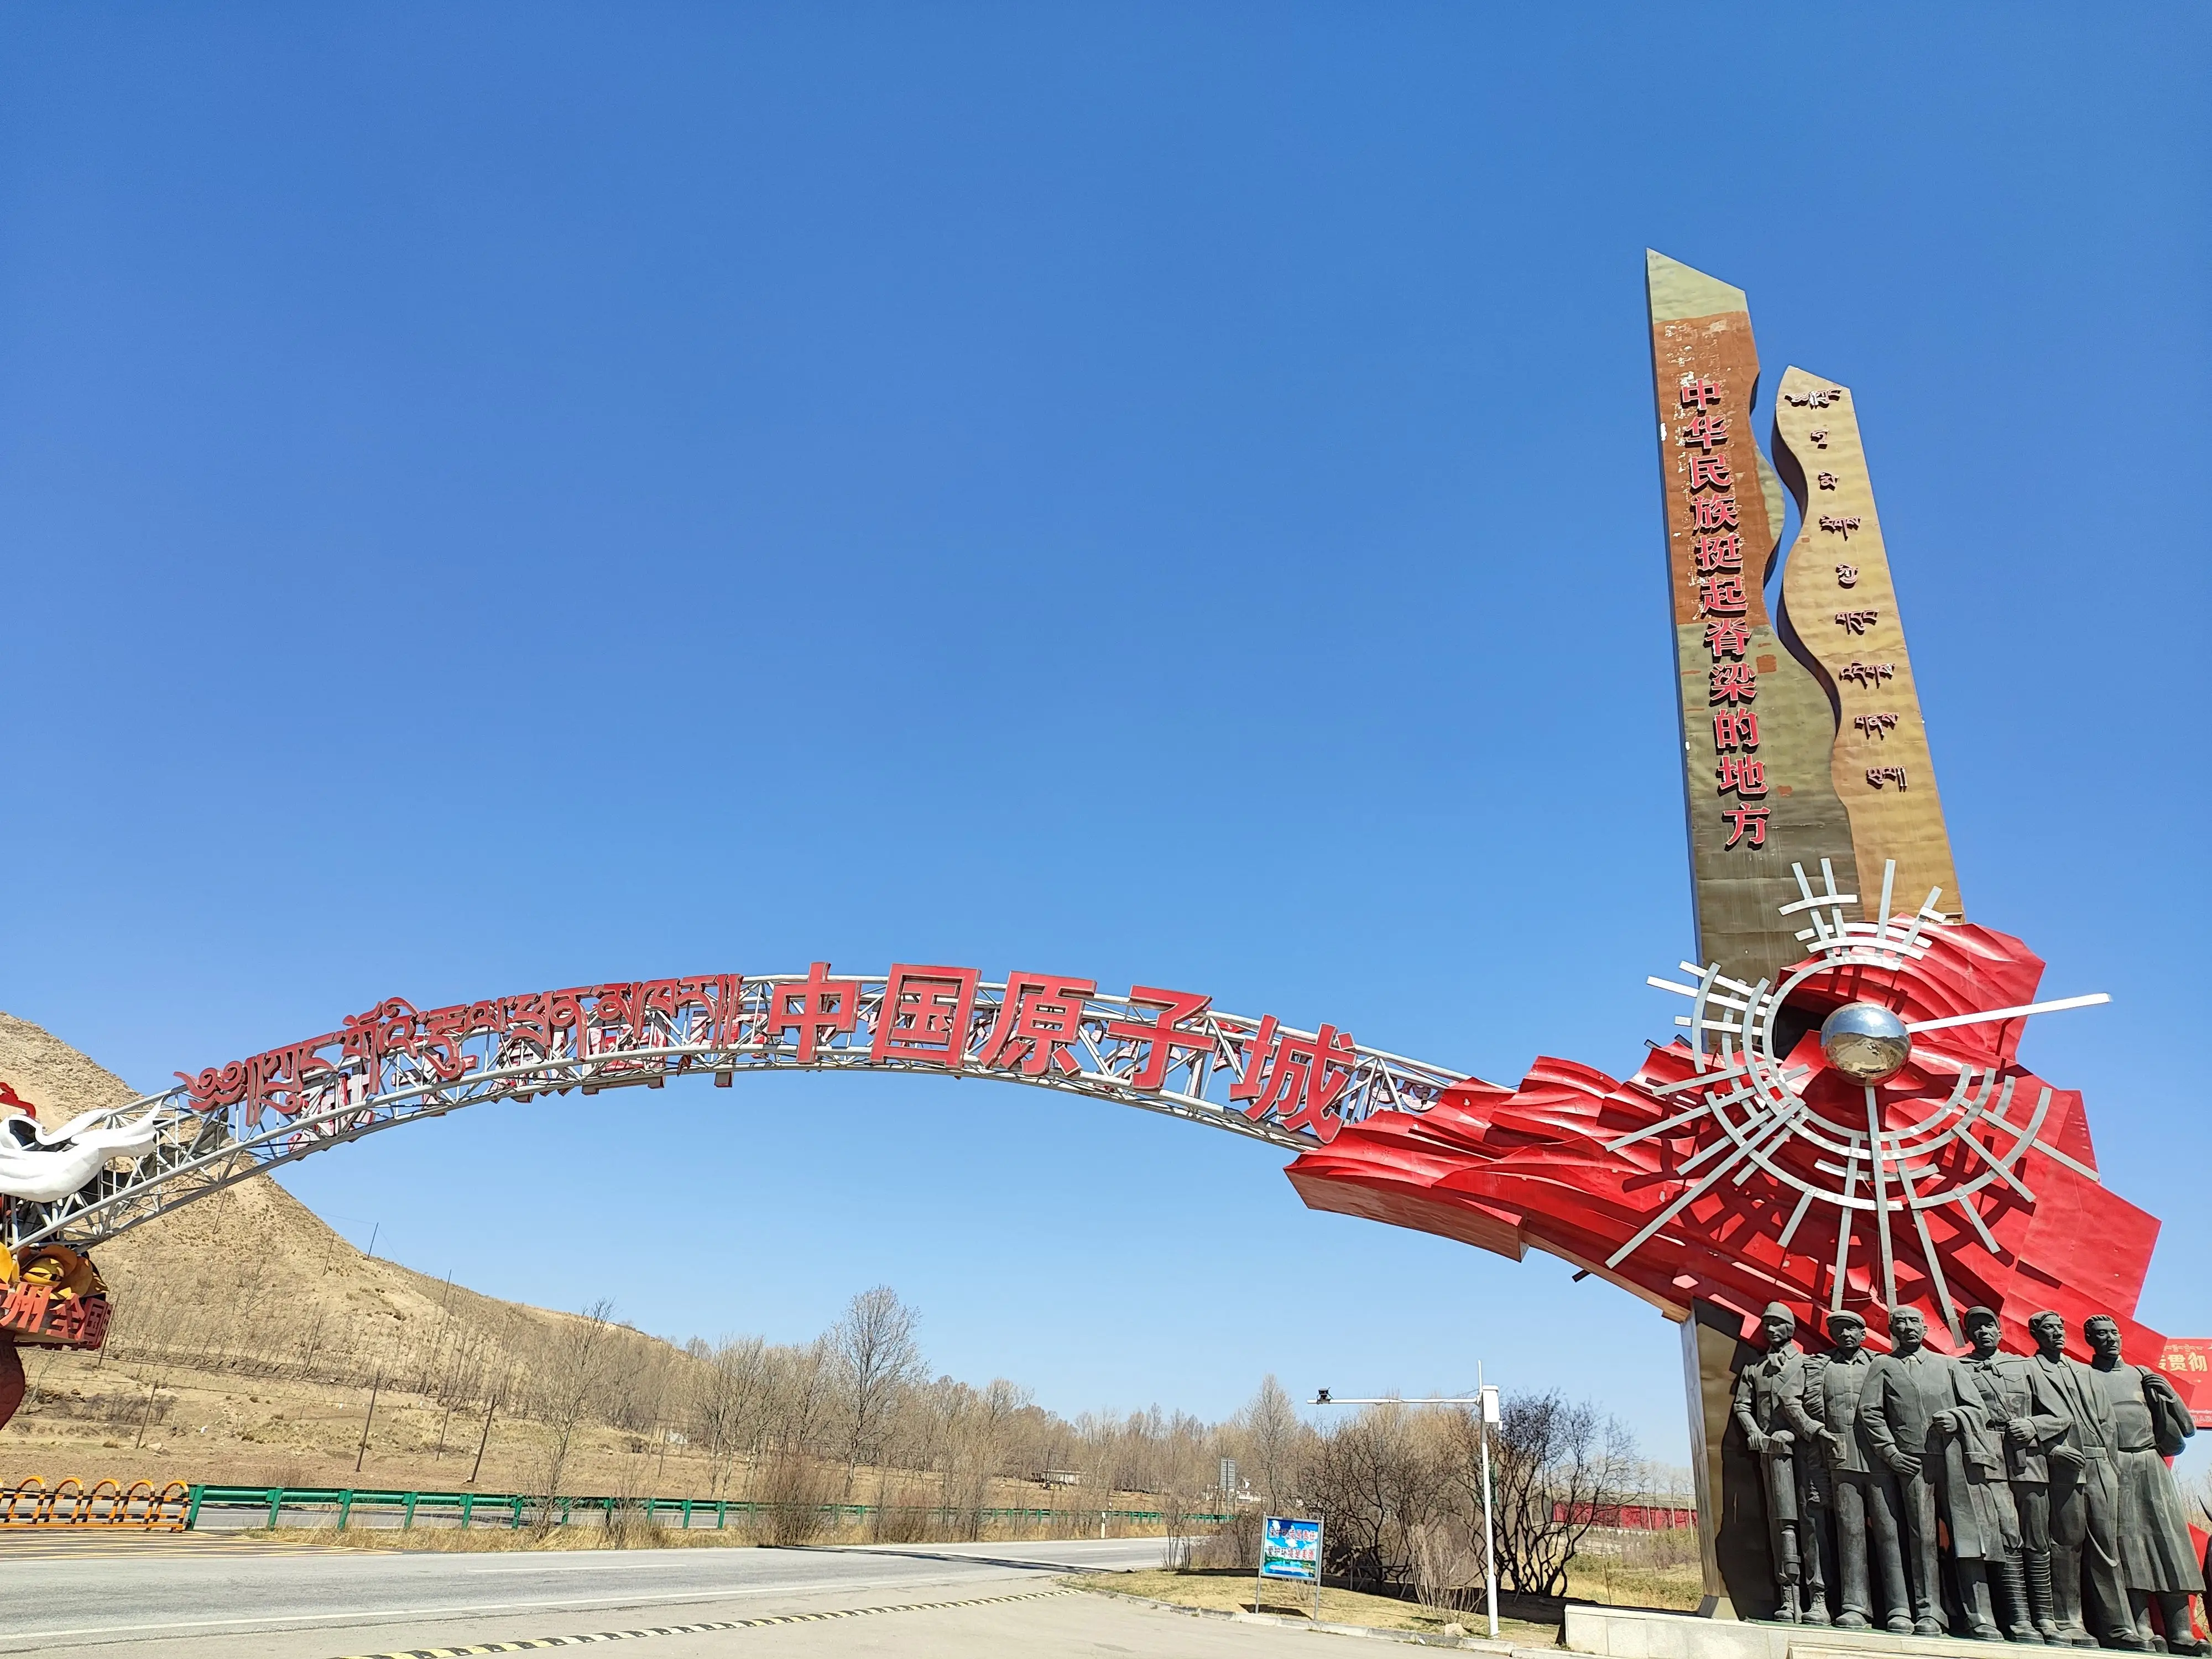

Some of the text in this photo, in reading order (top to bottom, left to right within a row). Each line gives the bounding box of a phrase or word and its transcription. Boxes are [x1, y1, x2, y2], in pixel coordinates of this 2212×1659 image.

[1681, 378, 1771, 848] 中华民族挺起脊梁的地方
[768, 962, 1358, 1144] 中国原子城
[0, 1281, 113, 1348] 州全国
